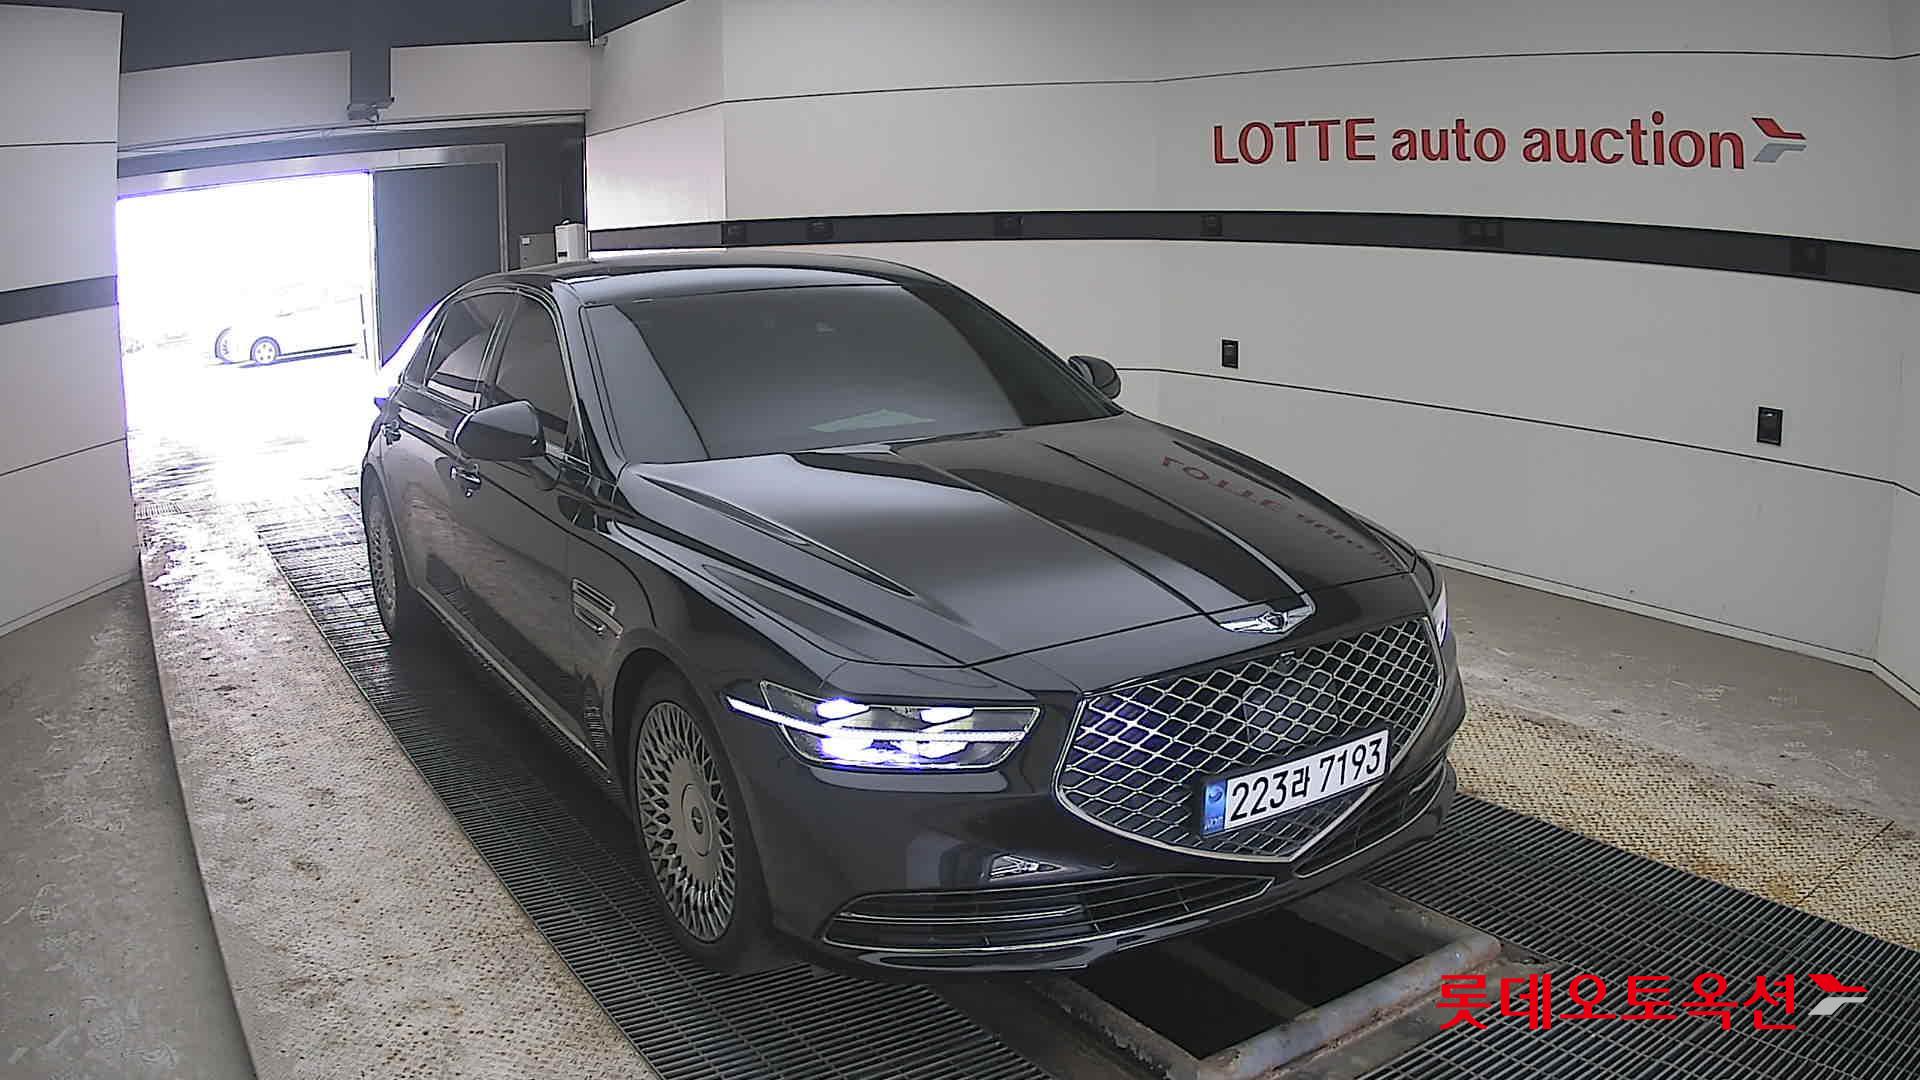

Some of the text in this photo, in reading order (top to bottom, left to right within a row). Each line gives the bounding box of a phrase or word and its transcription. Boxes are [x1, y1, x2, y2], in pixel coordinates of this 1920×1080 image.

[1212, 111, 1746, 170] LOTTE auto auction
[1229, 738, 1383, 822] 223라 7193
